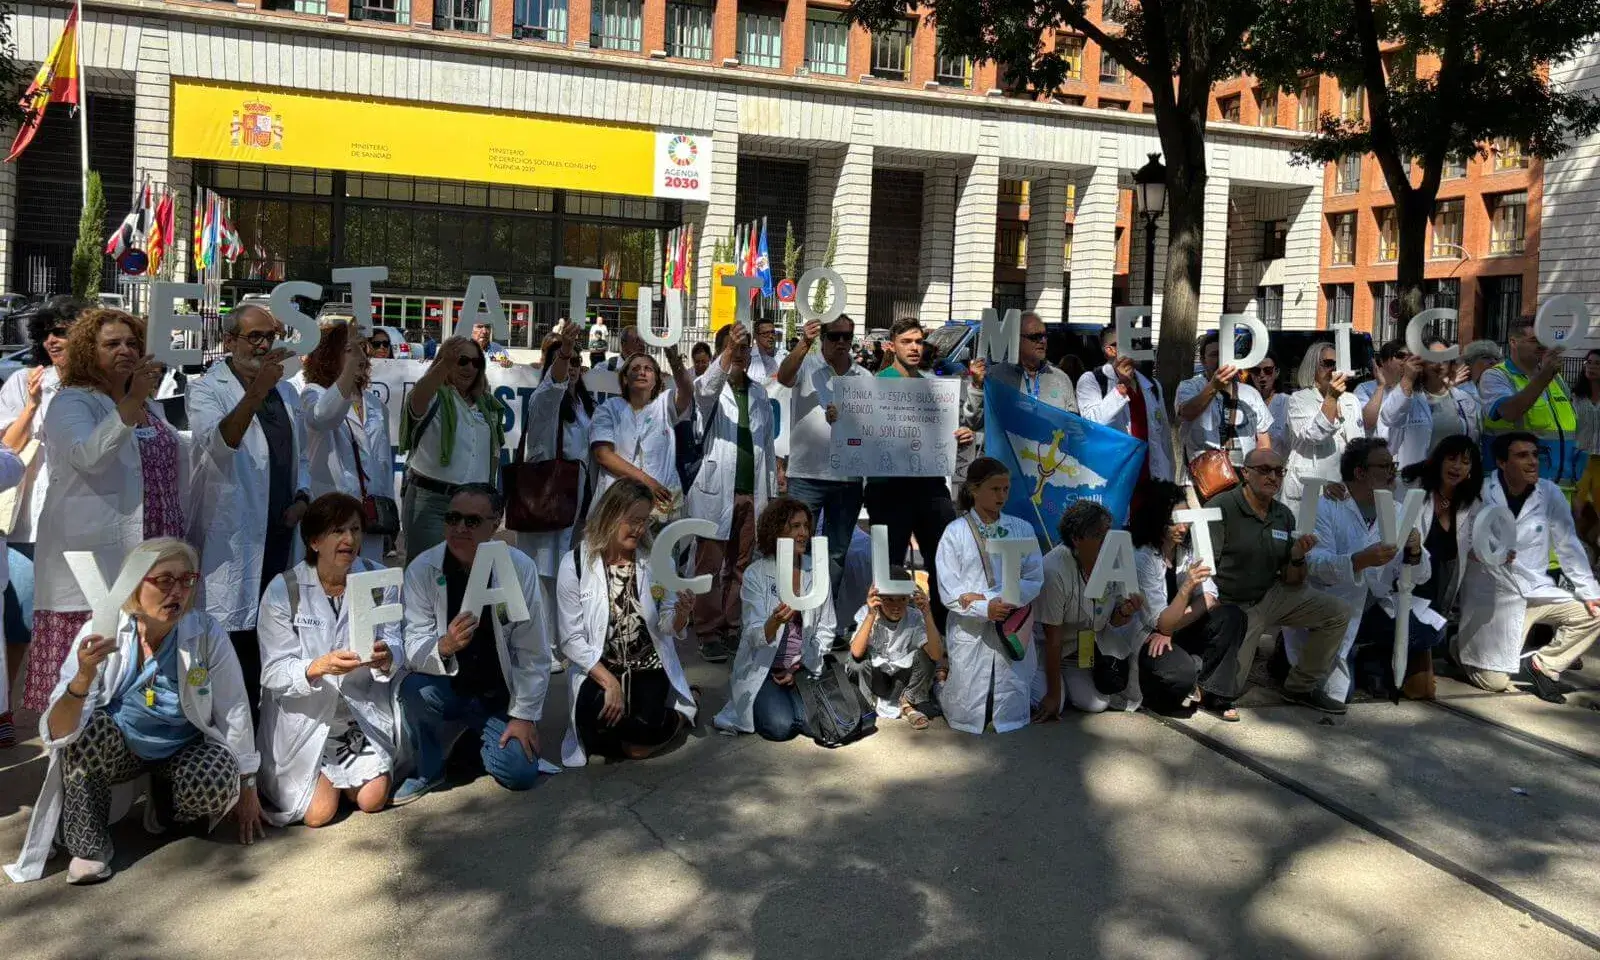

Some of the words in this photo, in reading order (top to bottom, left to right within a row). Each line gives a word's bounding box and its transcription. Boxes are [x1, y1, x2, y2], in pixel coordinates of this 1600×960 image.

[351, 142, 389, 152] MINISTERIO
[489, 147, 525, 156] MINISTERIO
[361, 151, 392, 160] SANIDAD
[494, 163, 520, 171] AGENDA
[522, 165, 536, 173] 2030
[499, 156, 533, 165] DERECHOS
[564, 162, 597, 171] CONSUMO
[664, 168, 699, 178] AGENDA
[664, 177, 699, 190] 2030
[878, 391, 886, 401] SI
[917, 391, 956, 405] BUSCANDO
[862, 425, 874, 437] NO
[879, 426, 896, 438] SON
